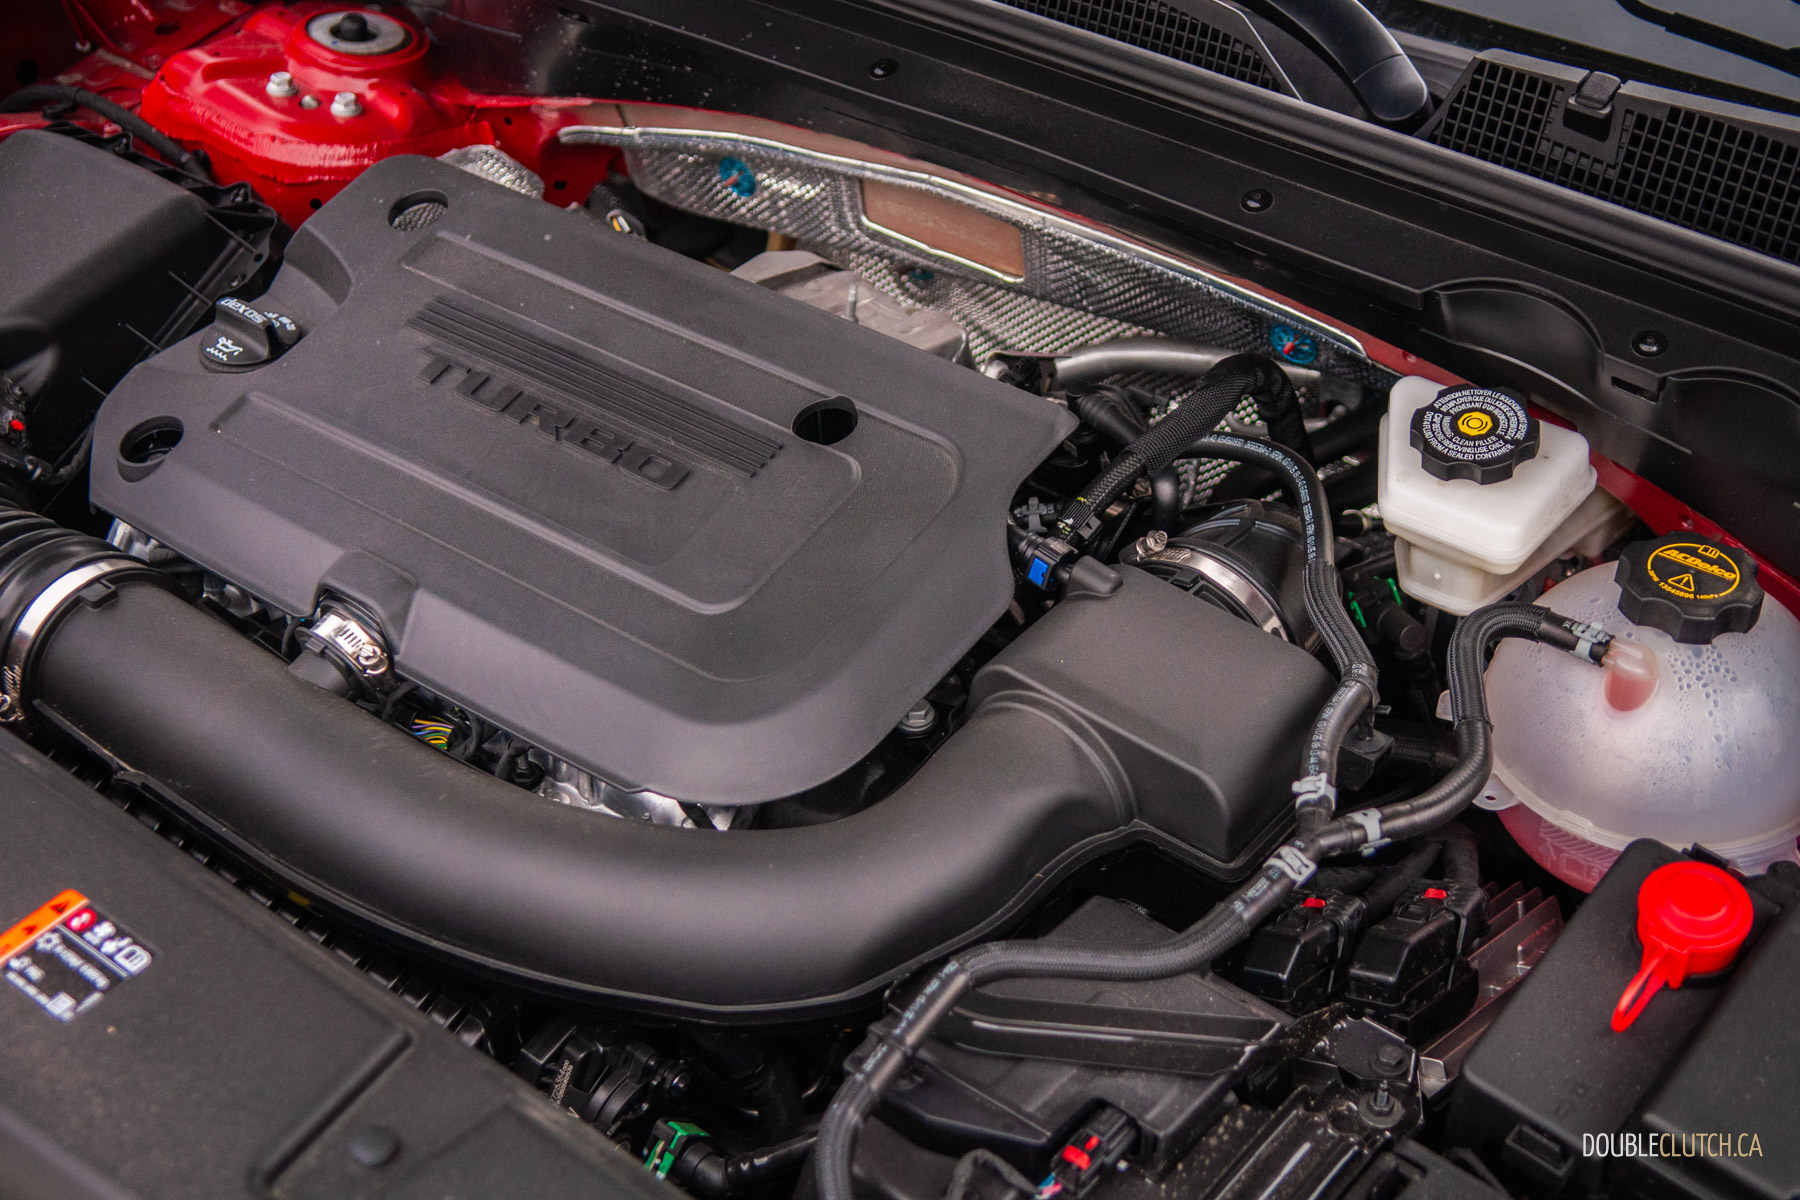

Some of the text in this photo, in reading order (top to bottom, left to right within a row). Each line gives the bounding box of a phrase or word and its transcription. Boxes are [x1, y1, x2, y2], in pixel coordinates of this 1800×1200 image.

[220, 298, 268, 324] dexos
[416, 349, 690, 491] TURBO
[1452, 436, 1475, 447] CLEAN
[1475, 435, 1499, 447] FILLER
[1447, 450, 1475, 460] SEALED
[1658, 548, 1737, 581] ACDelco
